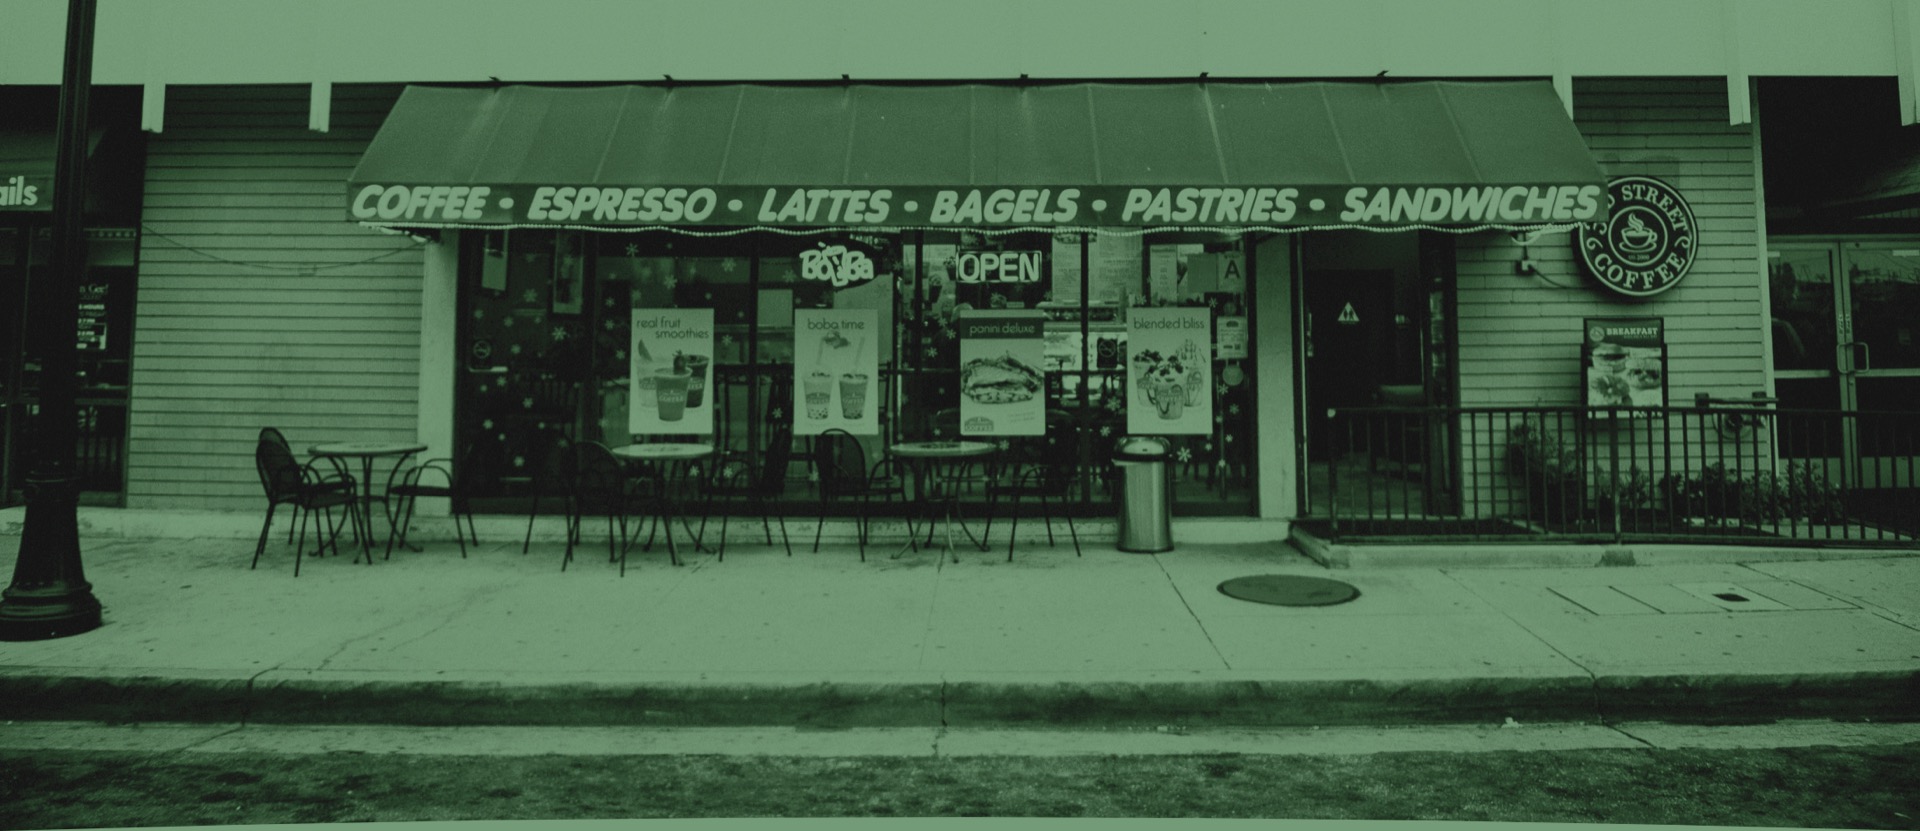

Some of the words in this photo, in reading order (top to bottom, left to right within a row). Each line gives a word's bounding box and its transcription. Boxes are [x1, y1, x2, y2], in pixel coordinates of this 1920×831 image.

[352, 184, 491, 219] COFFEE
[527, 186, 717, 221] ESPRESSO
[757, 188, 892, 222] LATTES
[929, 188, 1081, 223] BAGELS
[1121, 187, 1299, 222] PASTRIES
[1340, 185, 1601, 222] SANDWICHES
[1621, 184, 1689, 231] STREET
[958, 252, 1040, 282] OPEN
[1223, 260, 1241, 280] A
[1594, 252, 1686, 290] COFFEE
[636, 316, 658, 328] real
[660, 315, 681, 328] fruit
[807, 317, 839, 330] boba
[841, 319, 865, 330] time
[1133, 317, 1181, 329] blended
[1183, 317, 1205, 329] bliss
[655, 327, 709, 339] smoothies
[969, 324, 1001, 337] panini
[1002, 322, 1035, 334] deluxe
[1606, 327, 1658, 336] BREAKFAST
